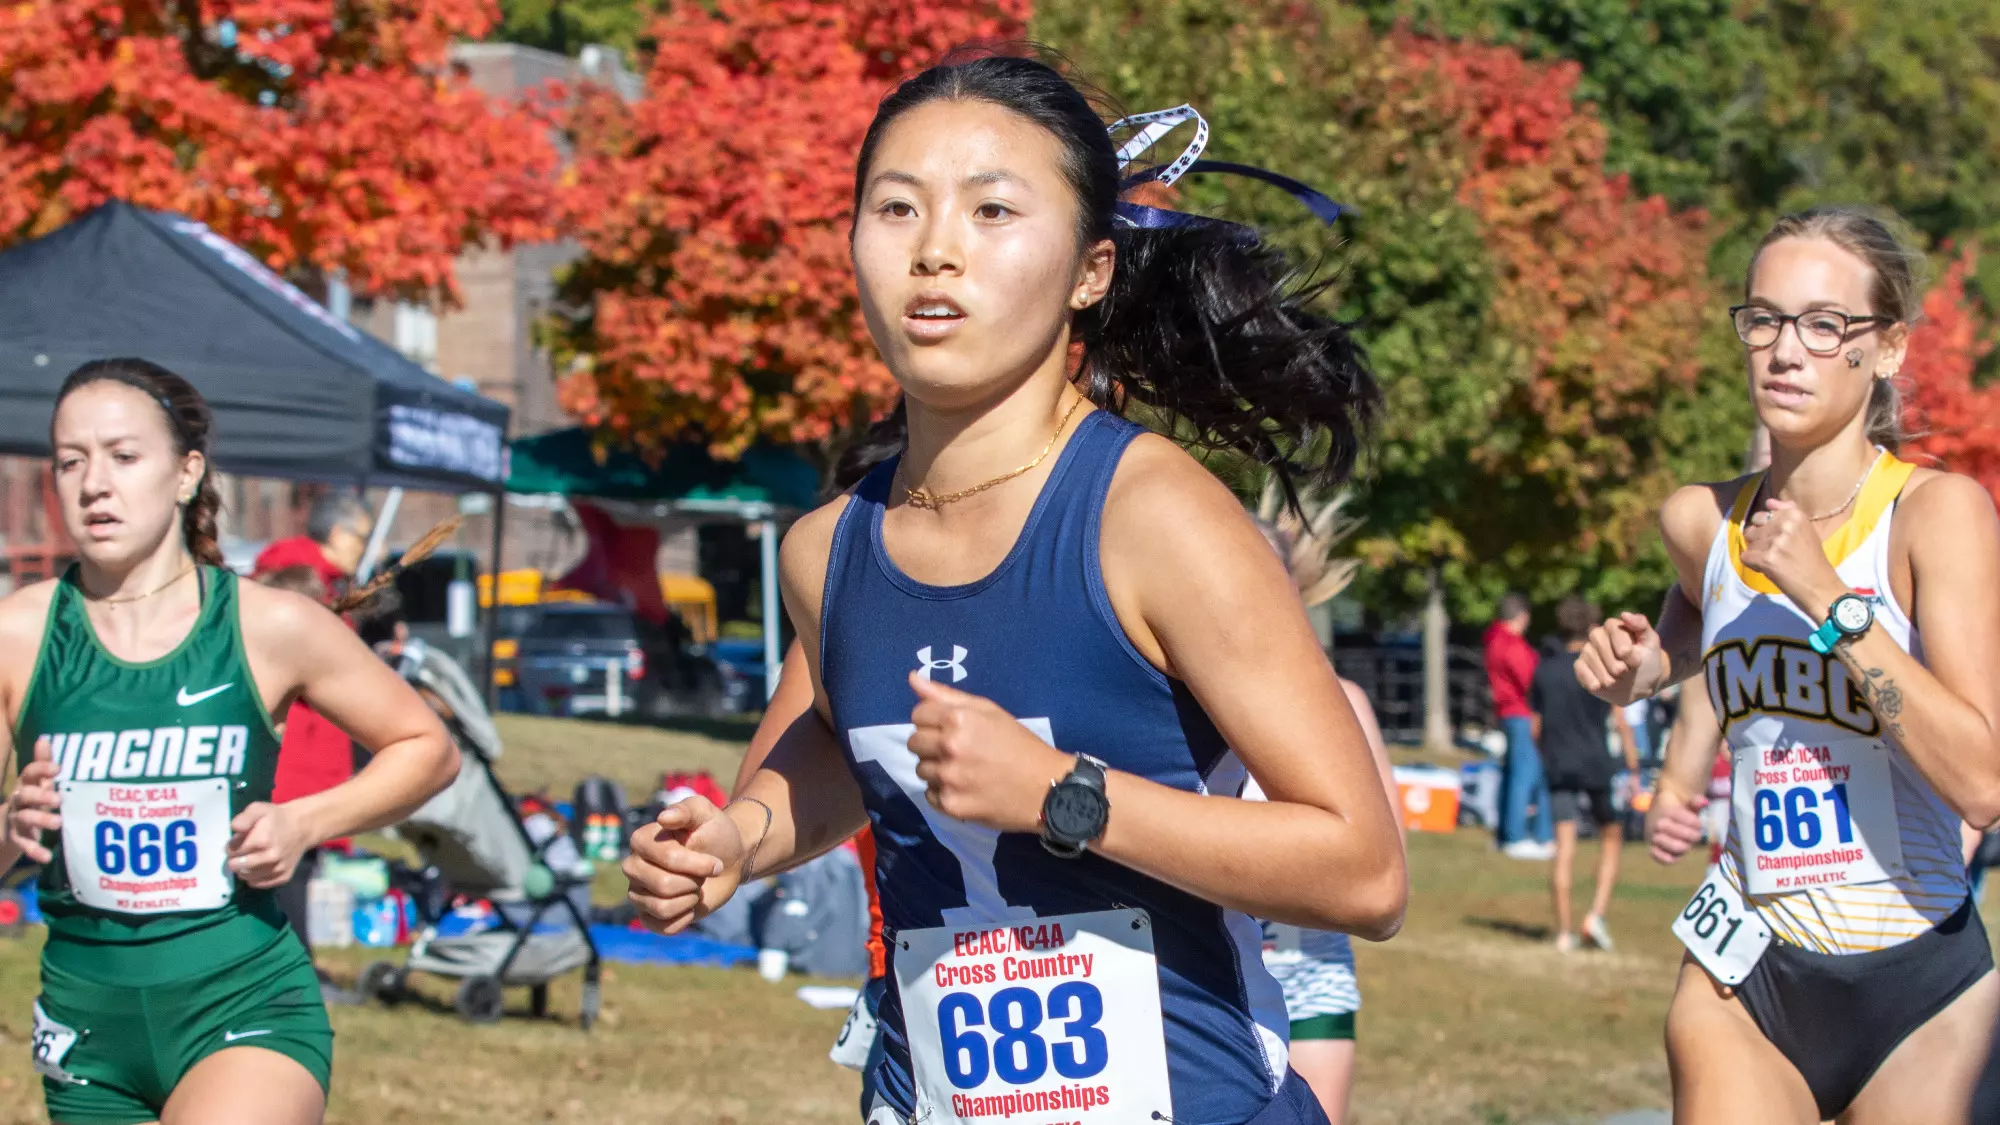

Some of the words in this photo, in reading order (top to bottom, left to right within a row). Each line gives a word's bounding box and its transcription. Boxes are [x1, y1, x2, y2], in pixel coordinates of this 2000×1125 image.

[37, 725, 249, 781] WAGNER
[1764, 746, 1832, 766] ECAC/IC4A
[1754, 769, 1788, 785] Cross
[1793, 765, 1850, 783] Country
[95, 803, 133, 819] Cross
[138, 804, 195, 818] Country
[1754, 783, 1853, 851] 661
[95, 819, 198, 877] 666
[1757, 848, 1863, 871] Championships
[99, 876, 197, 894] Championships
[1794, 871, 1847, 887] ATHLETIC
[132, 898, 180, 909] ATHLETIC
[1683, 882, 1743, 957] 661
[954, 923, 1065, 957] ECAC/IC4A
[935, 962, 996, 988] Cross
[1003, 953, 1093, 982] Country
[937, 980, 1109, 1089] 683
[952, 1083, 1110, 1118] Championships
